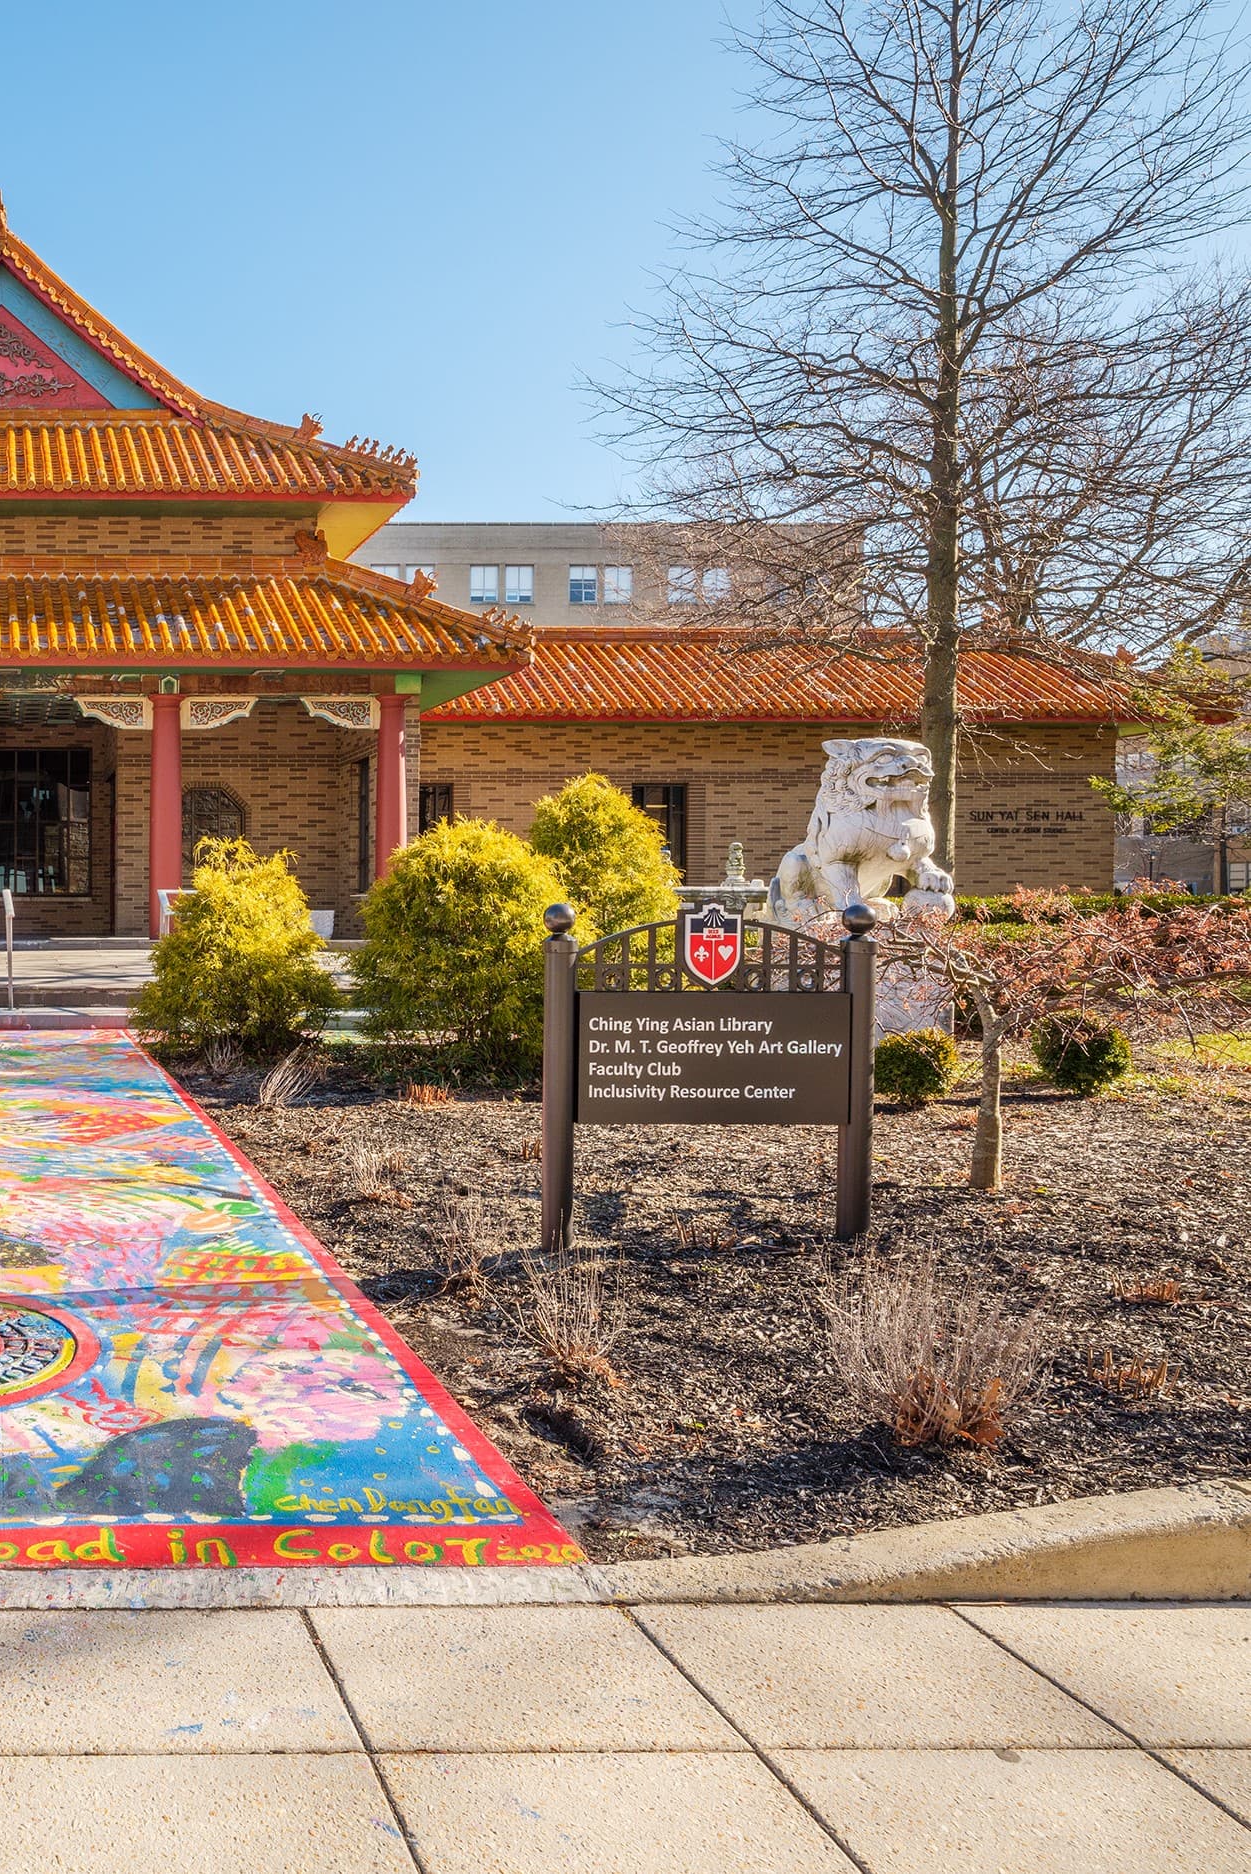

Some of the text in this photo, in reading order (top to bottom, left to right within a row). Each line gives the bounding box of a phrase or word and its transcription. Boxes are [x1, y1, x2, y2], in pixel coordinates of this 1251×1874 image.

[969, 810, 993, 822] SUN
[1026, 810, 1050, 822] SEN
[588, 1017, 773, 1034] Ching Ying Asian Library
[588, 1040, 843, 1057] Dr. M. T. Geoffrey Yeh Art Gallery
[588, 1062, 681, 1078] Faculty Club
[588, 1085, 795, 1101] Inclusivity Resource Center
[166, 1529, 236, 1566] in
[273, 1529, 492, 1566] Color
